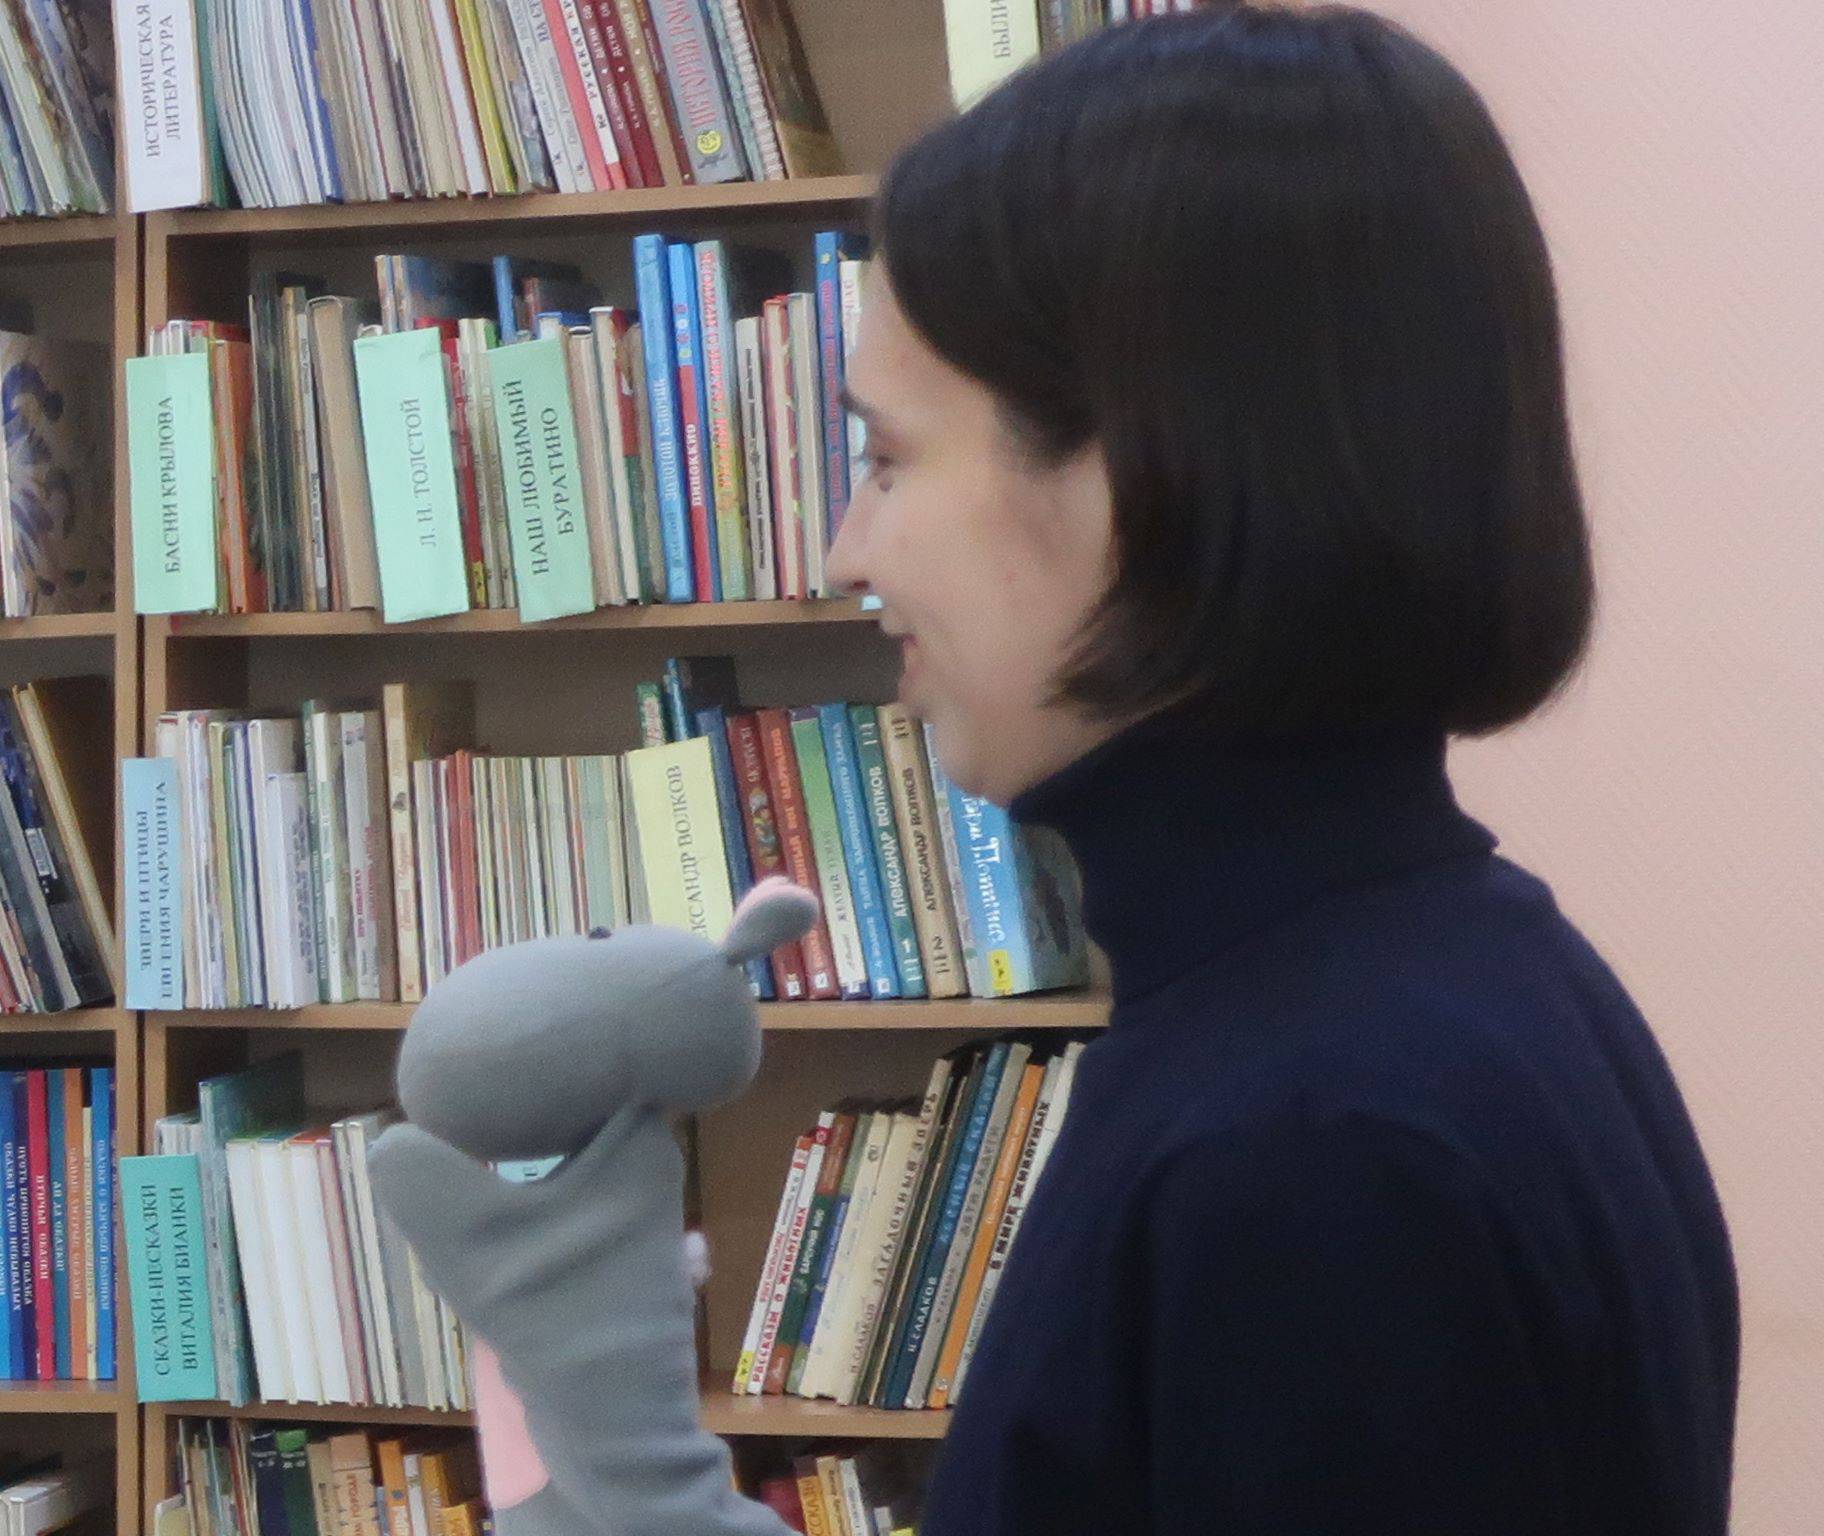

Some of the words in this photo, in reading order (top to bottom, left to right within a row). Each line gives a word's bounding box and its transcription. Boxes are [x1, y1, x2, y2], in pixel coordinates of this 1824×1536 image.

[136, 4, 160, 158] ИСТОРИЧЕСКАЯ
[158, 14, 181, 140] ЛИТЕРАТУРА
[157, 397, 176, 499] КРЫЛОВА
[400, 396, 429, 496] ТОЛСТОЙ
[501, 379, 540, 510] ЛЮБИМЫЙ
[541, 407, 574, 535] БУРАТИНО
[684, 423, 703, 506] ПИНОККИО
[161, 503, 180, 574] БАСНИ
[419, 527, 437, 548] Л.
[525, 517, 550, 575] НАШ
[666, 765, 693, 848] ВОЛКОВ
[867, 765, 891, 828] ВОЛКОВ
[901, 766, 922, 827] ВОЛКОВ
[136, 810, 150, 884] ПТИЦЫ
[155, 781, 170, 901] ЧАРУШИНА
[880, 829, 909, 918] АЛЕКСАНДР
[912, 829, 937, 912] АЛЕКСАНДР
[139, 890, 150, 903] И
[679, 851, 707, 940] КСАНДР
[139, 910, 152, 967] ЗВЕРИ
[159, 906, 172, 998] ЕВГЕНИЯ
[4, 1141, 15, 1188] СКАЗКИ
[18, 1146, 28, 1183] ПУСТЬ
[35, 1174, 46, 1224] ПТИЧЬИ
[96, 1139, 106, 1183] СКАЗКИ
[994, 1206, 1017, 1255] МИРЕ
[1010, 1100, 1048, 1200] ЖИВОТНЫХ
[37, 1232, 48, 1279] СКАЗКИ
[169, 1187, 190, 1269] БИАНКИ
[778, 1204, 807, 1285] ЖИВОТНЫХ
[8, 1236, 20, 1311] НЕБЫВАЛЫХ
[21, 1261, 31, 1304] СКАЗКА
[140, 1184, 171, 1376] СКАЗКИ-НЕСКАЗКИ
[911, 1274, 937, 1339] СЛАДКОВ
[176, 1275, 198, 1370] ВИТАЛИЯ
